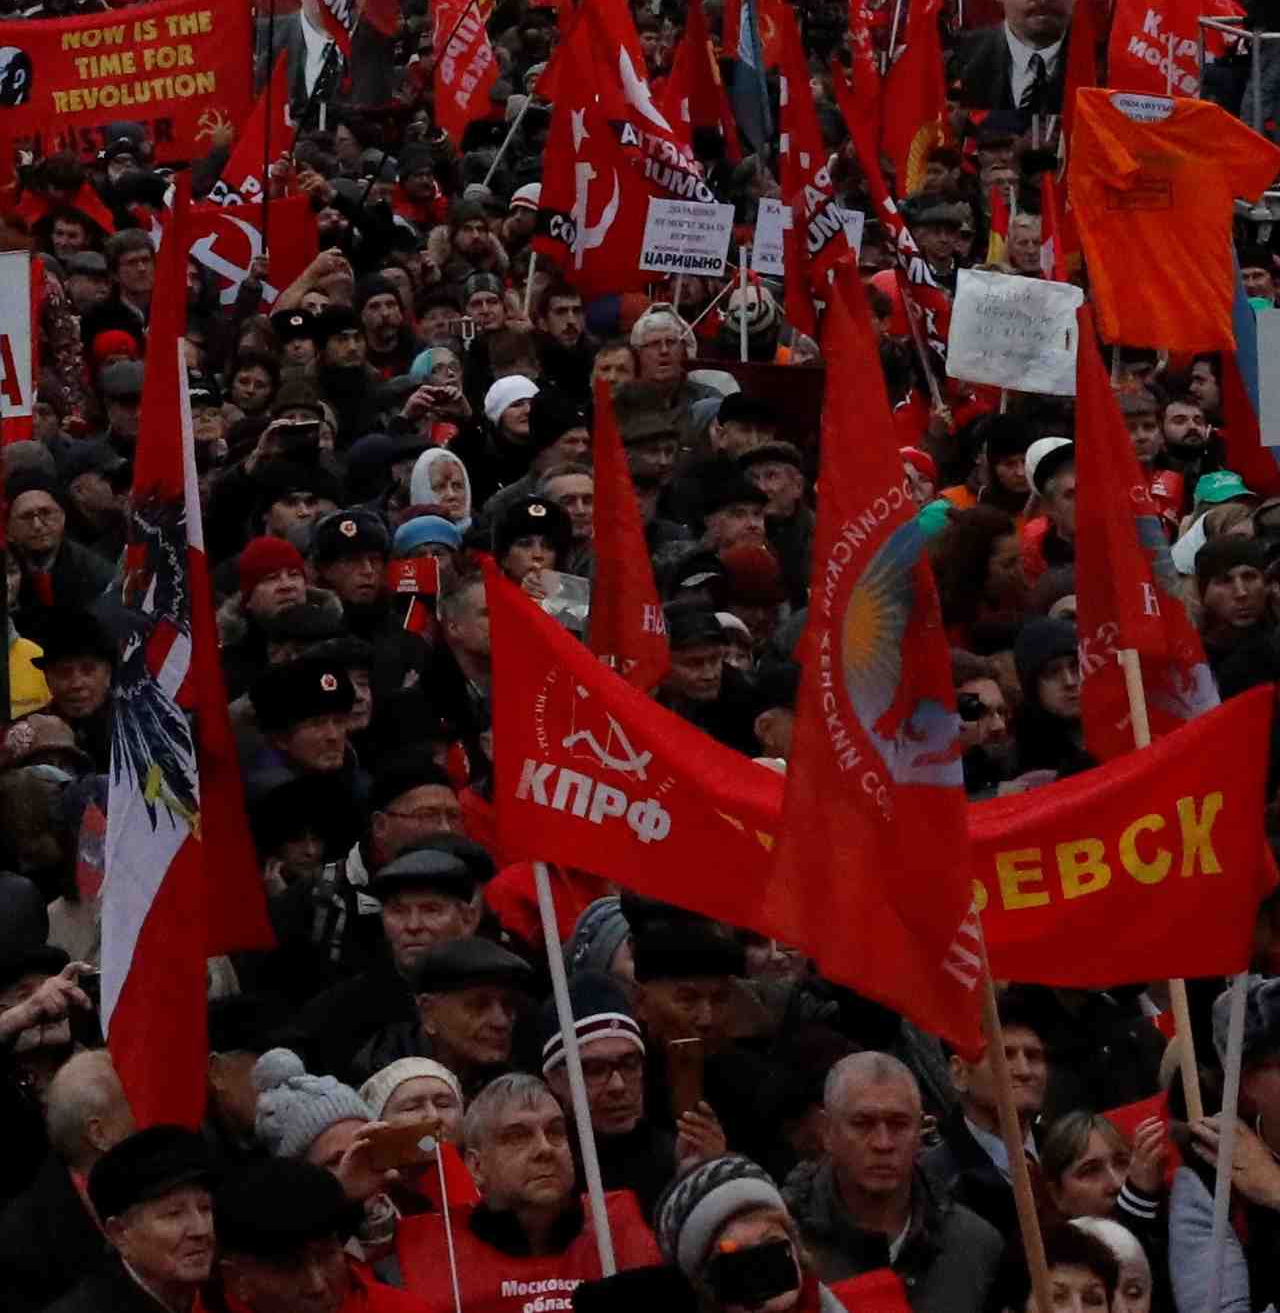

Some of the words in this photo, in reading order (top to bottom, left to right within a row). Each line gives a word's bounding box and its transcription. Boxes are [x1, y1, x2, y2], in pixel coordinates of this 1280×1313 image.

[61, 25, 126, 50] NOW
[133, 19, 159, 42] IS
[166, 10, 214, 36] THE
[75, 51, 136, 79] TIME
[143, 44, 195, 70] FOR
[52, 71, 216, 103] REVOLUTION
[644, 251, 722, 270] ЦАРИЦЫНО
[514, 758, 671, 845] КПРФ
